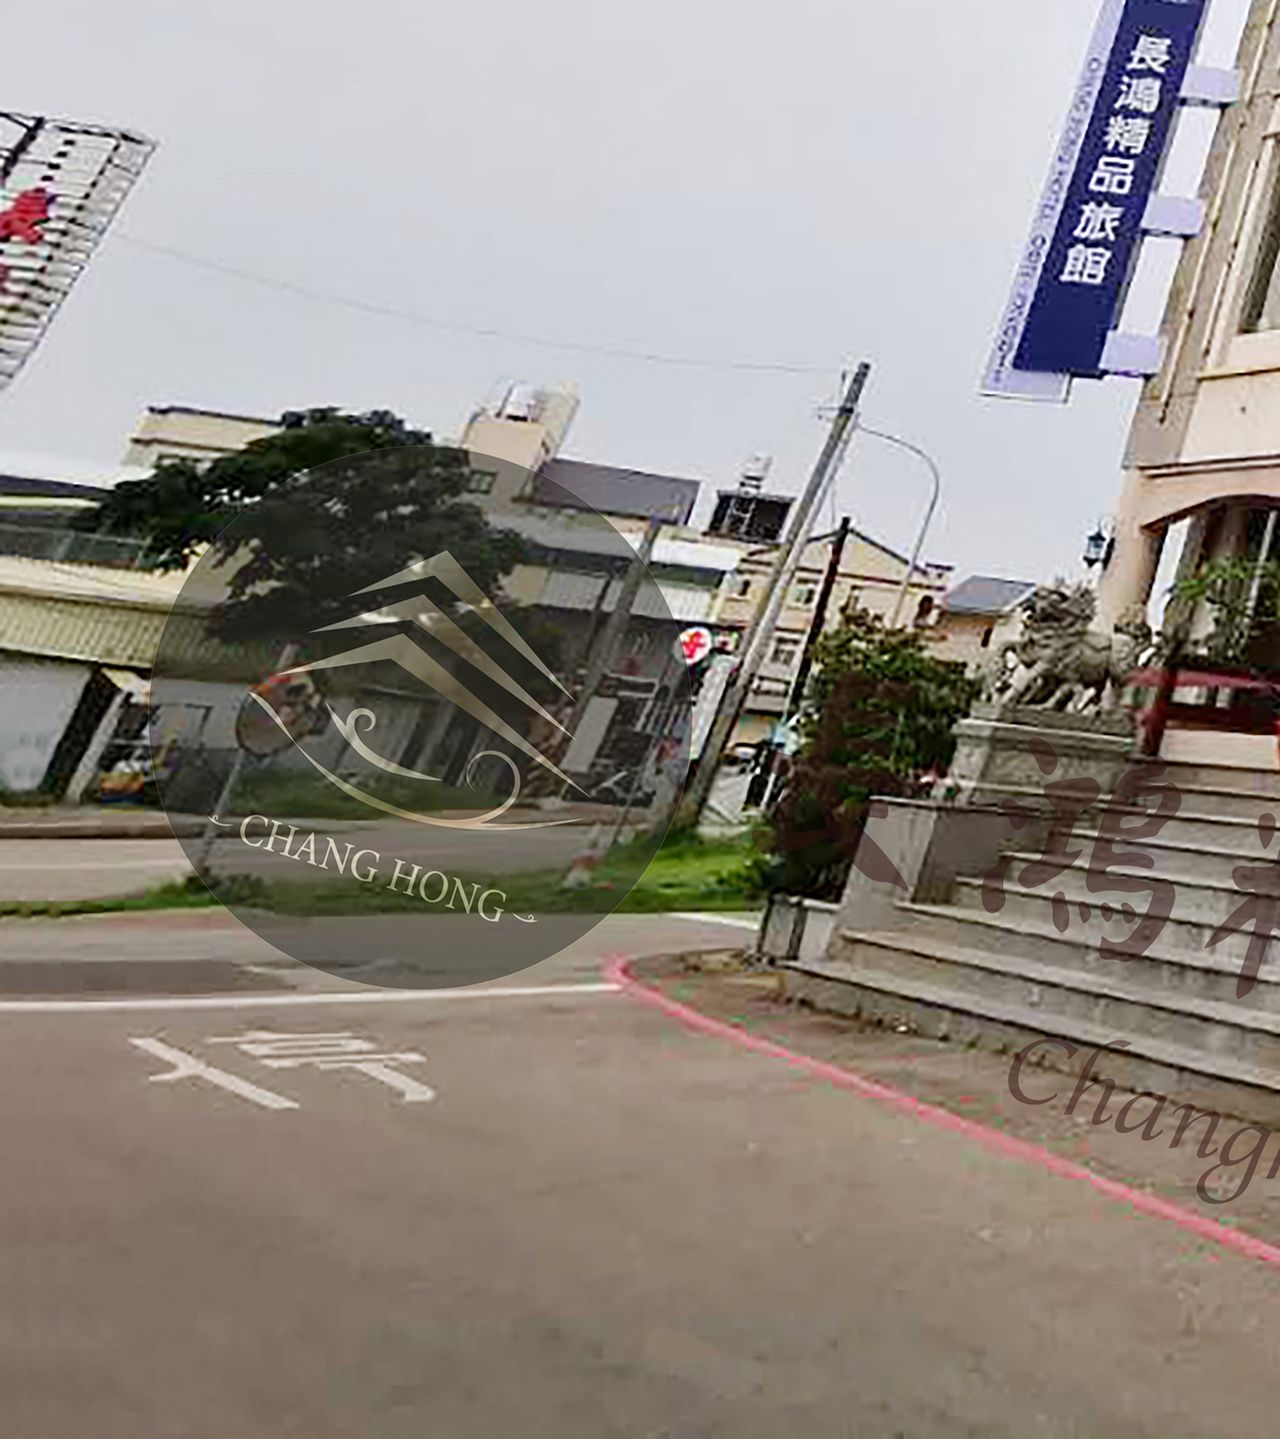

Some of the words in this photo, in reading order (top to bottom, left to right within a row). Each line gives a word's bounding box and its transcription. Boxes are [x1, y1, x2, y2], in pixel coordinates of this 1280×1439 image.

[1059, 35, 1171, 285] 長鴻精品旅館
